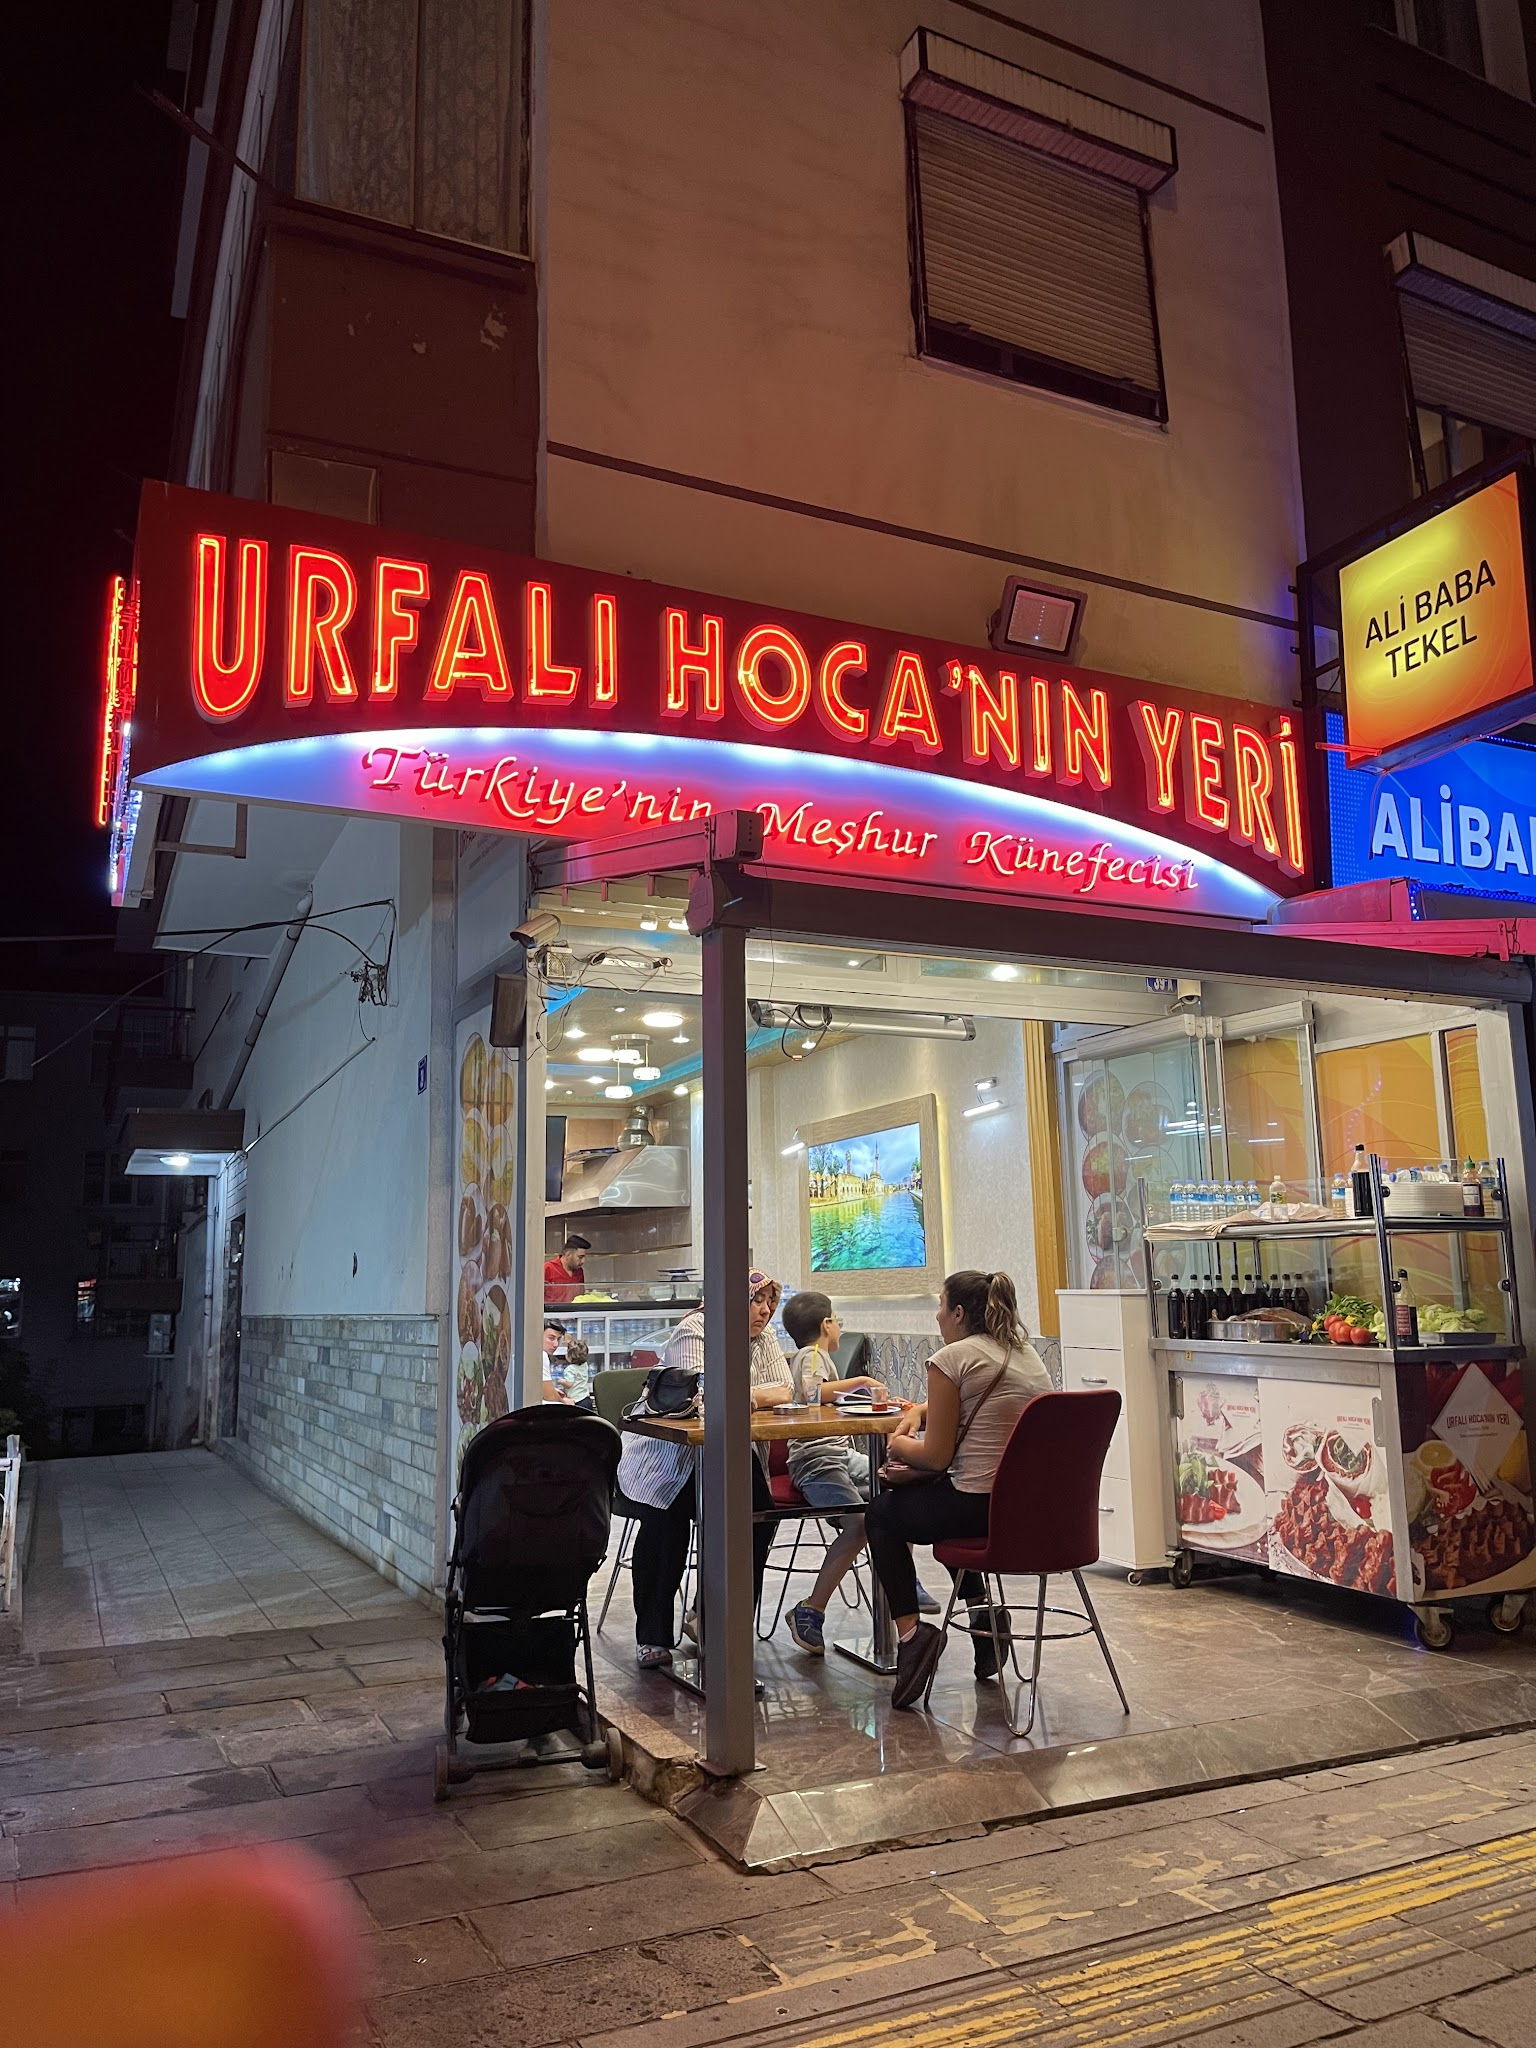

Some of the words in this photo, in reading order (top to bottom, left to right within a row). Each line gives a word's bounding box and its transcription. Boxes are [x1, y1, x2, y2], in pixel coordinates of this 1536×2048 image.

[1365, 595, 1408, 649] ALİ
[1415, 559, 1496, 625] BABA
[1385, 615, 1478, 679] TEKEL
[193, 533, 617, 720] URFALI
[662, 607, 1111, 788] HOCA'NIN
[1129, 700, 1304, 876] YERİ
[365, 744, 712, 824] Türkiye'nin
[757, 801, 937, 857] Meşhur
[967, 832, 1198, 893] Künefecisi
[1372, 784, 1536, 876] ALİBA
